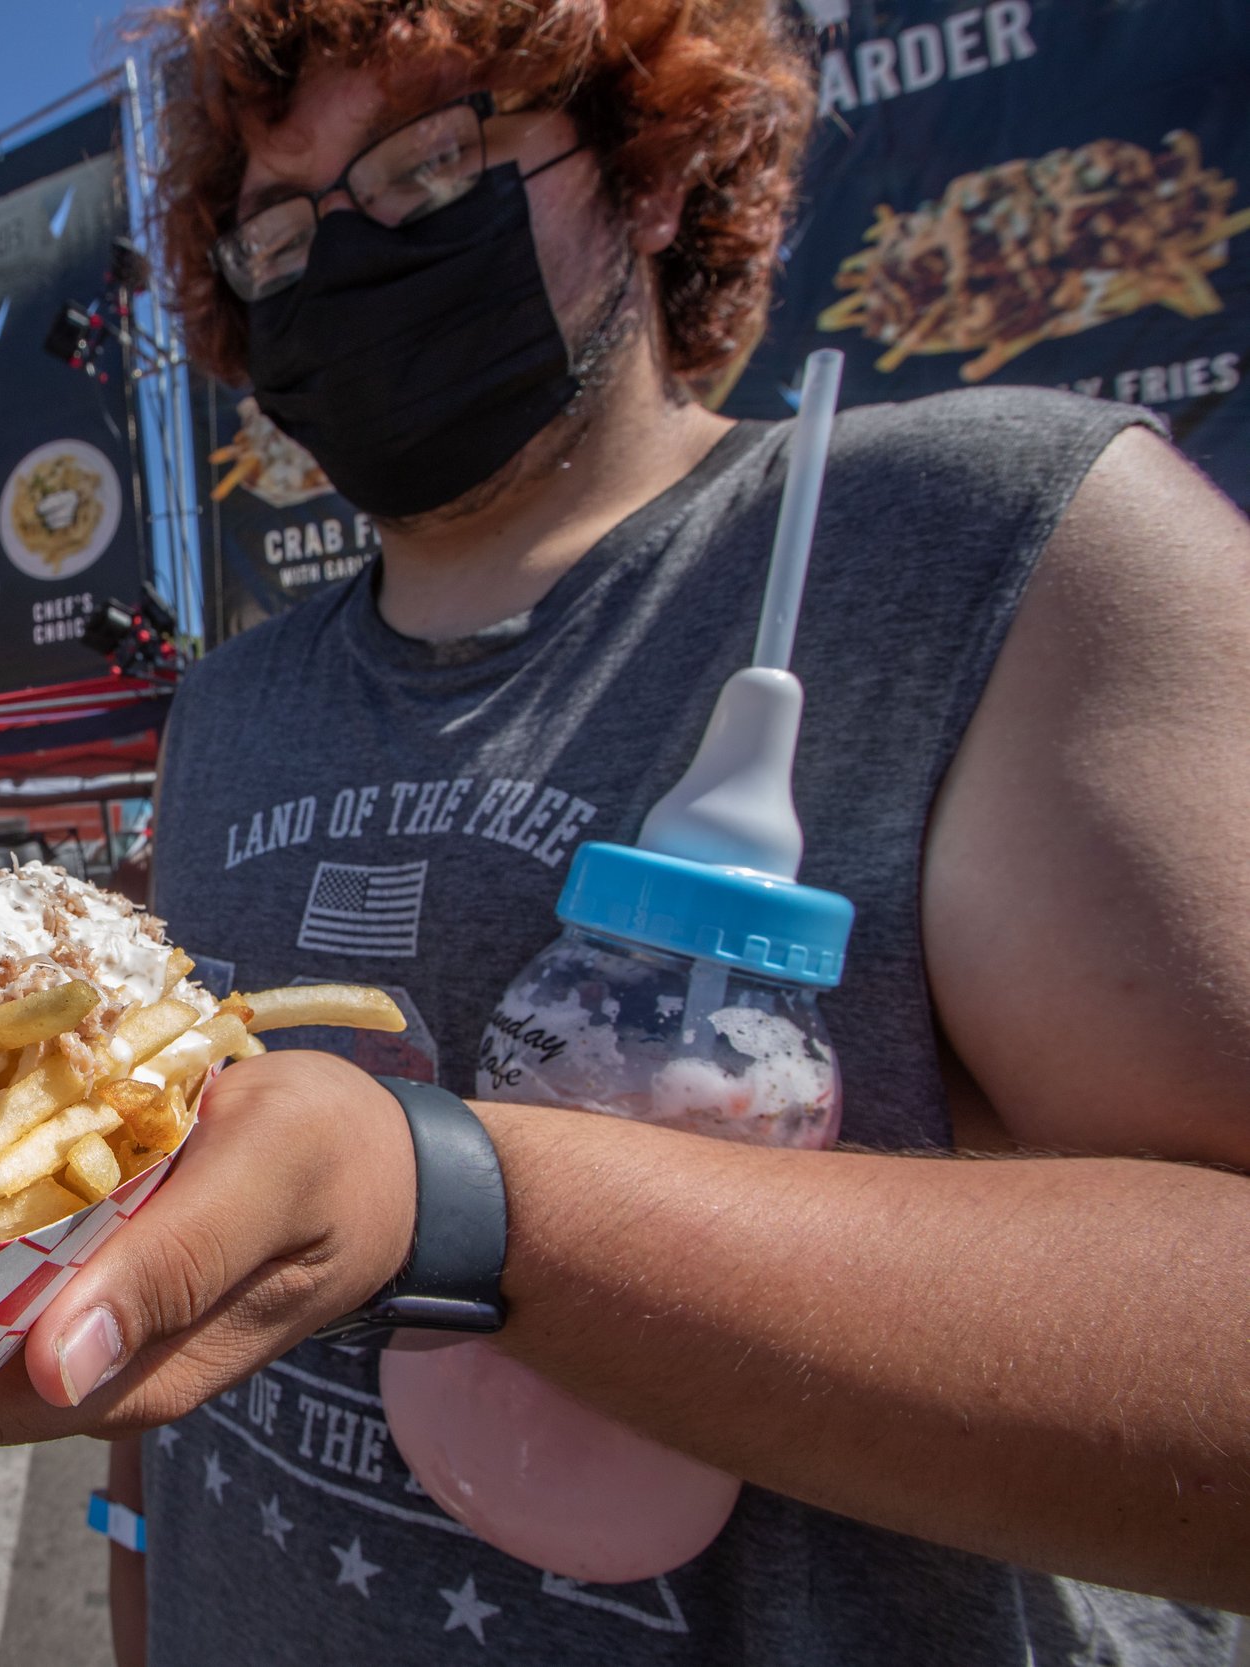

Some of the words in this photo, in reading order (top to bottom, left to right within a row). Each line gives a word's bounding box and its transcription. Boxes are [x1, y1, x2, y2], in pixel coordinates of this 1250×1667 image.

[1113, 352, 1241, 404] FRIES
[264, 519, 344, 565] CRAB
[279, 562, 321, 588] WITH
[32, 592, 94, 623] CHEF'S
[33, 616, 92, 646] CHOIC
[224, 795, 317, 870] LAND
[327, 786, 380, 839] OF
[386, 777, 476, 837] THE
[462, 777, 598, 869] FREE
[248, 1372, 282, 1436] OF
[298, 1393, 389, 1484] THE
